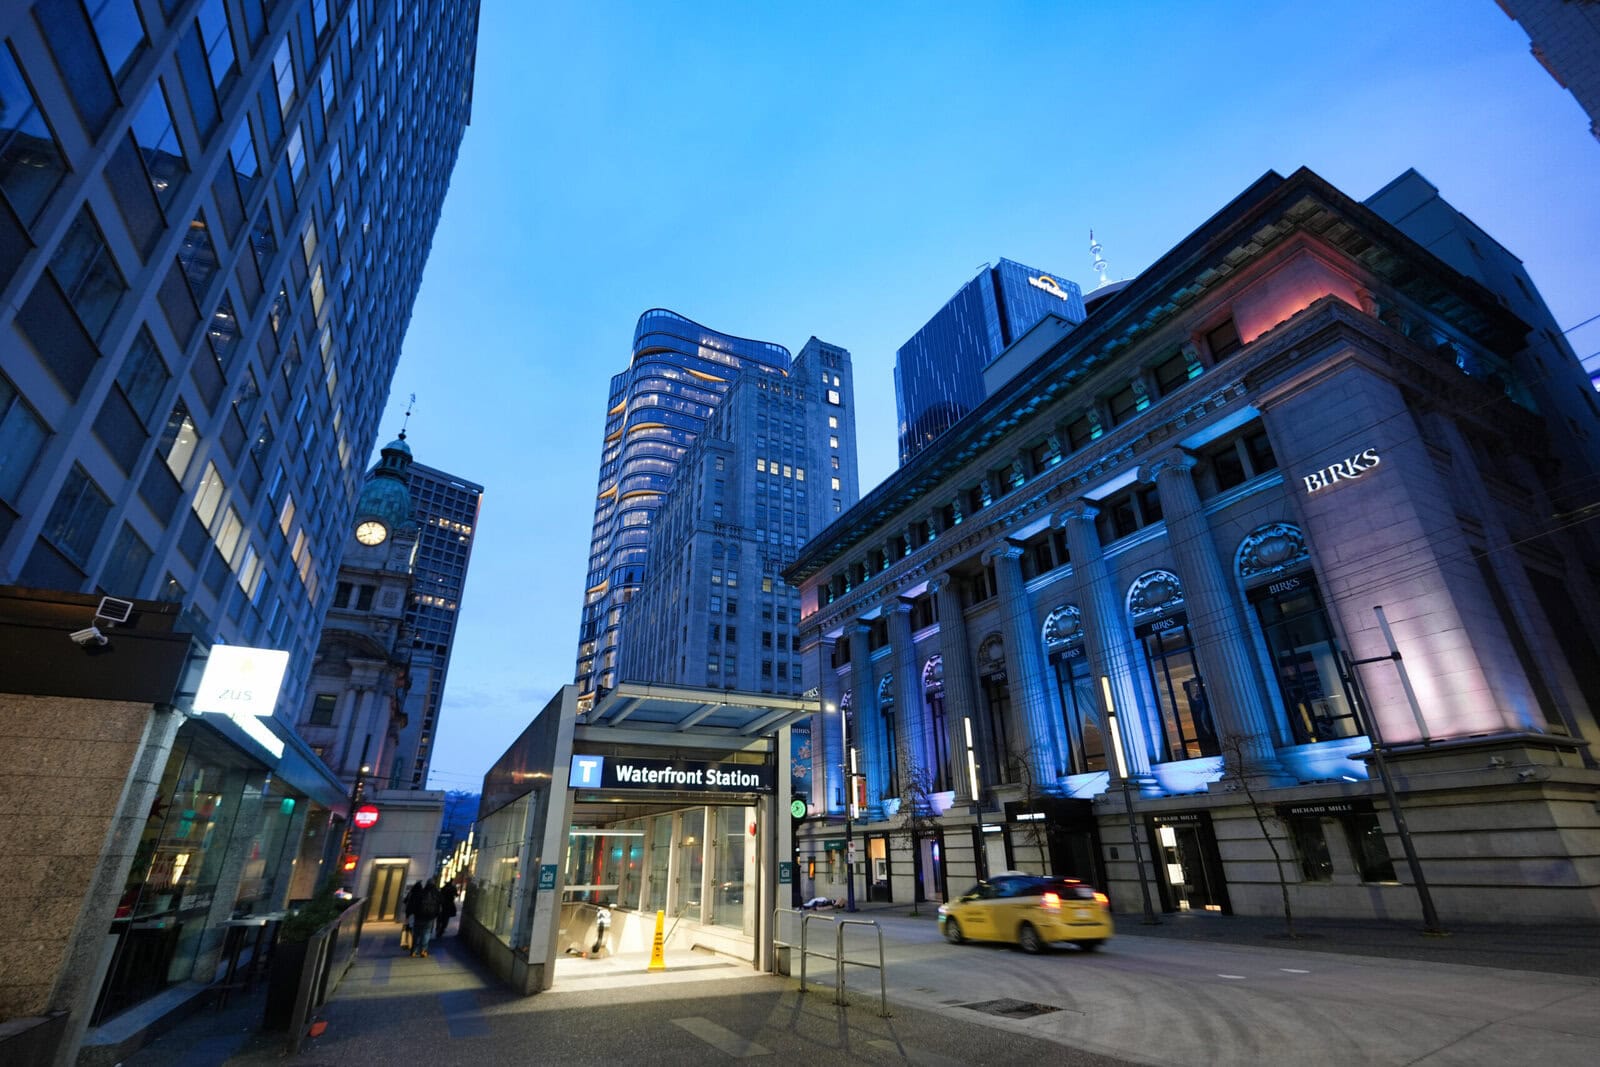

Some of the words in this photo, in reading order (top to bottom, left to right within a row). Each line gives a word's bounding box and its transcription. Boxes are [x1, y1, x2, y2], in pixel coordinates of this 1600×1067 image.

[1303, 447, 1380, 493] BIRKS
[1269, 577, 1300, 594] BIRKS
[1152, 617, 1175, 631] BIRKS
[579, 760, 598, 783] T
[616, 764, 702, 785] Waterfront
[705, 769, 760, 787] Station
[1291, 806, 1325, 814] RICHARD
